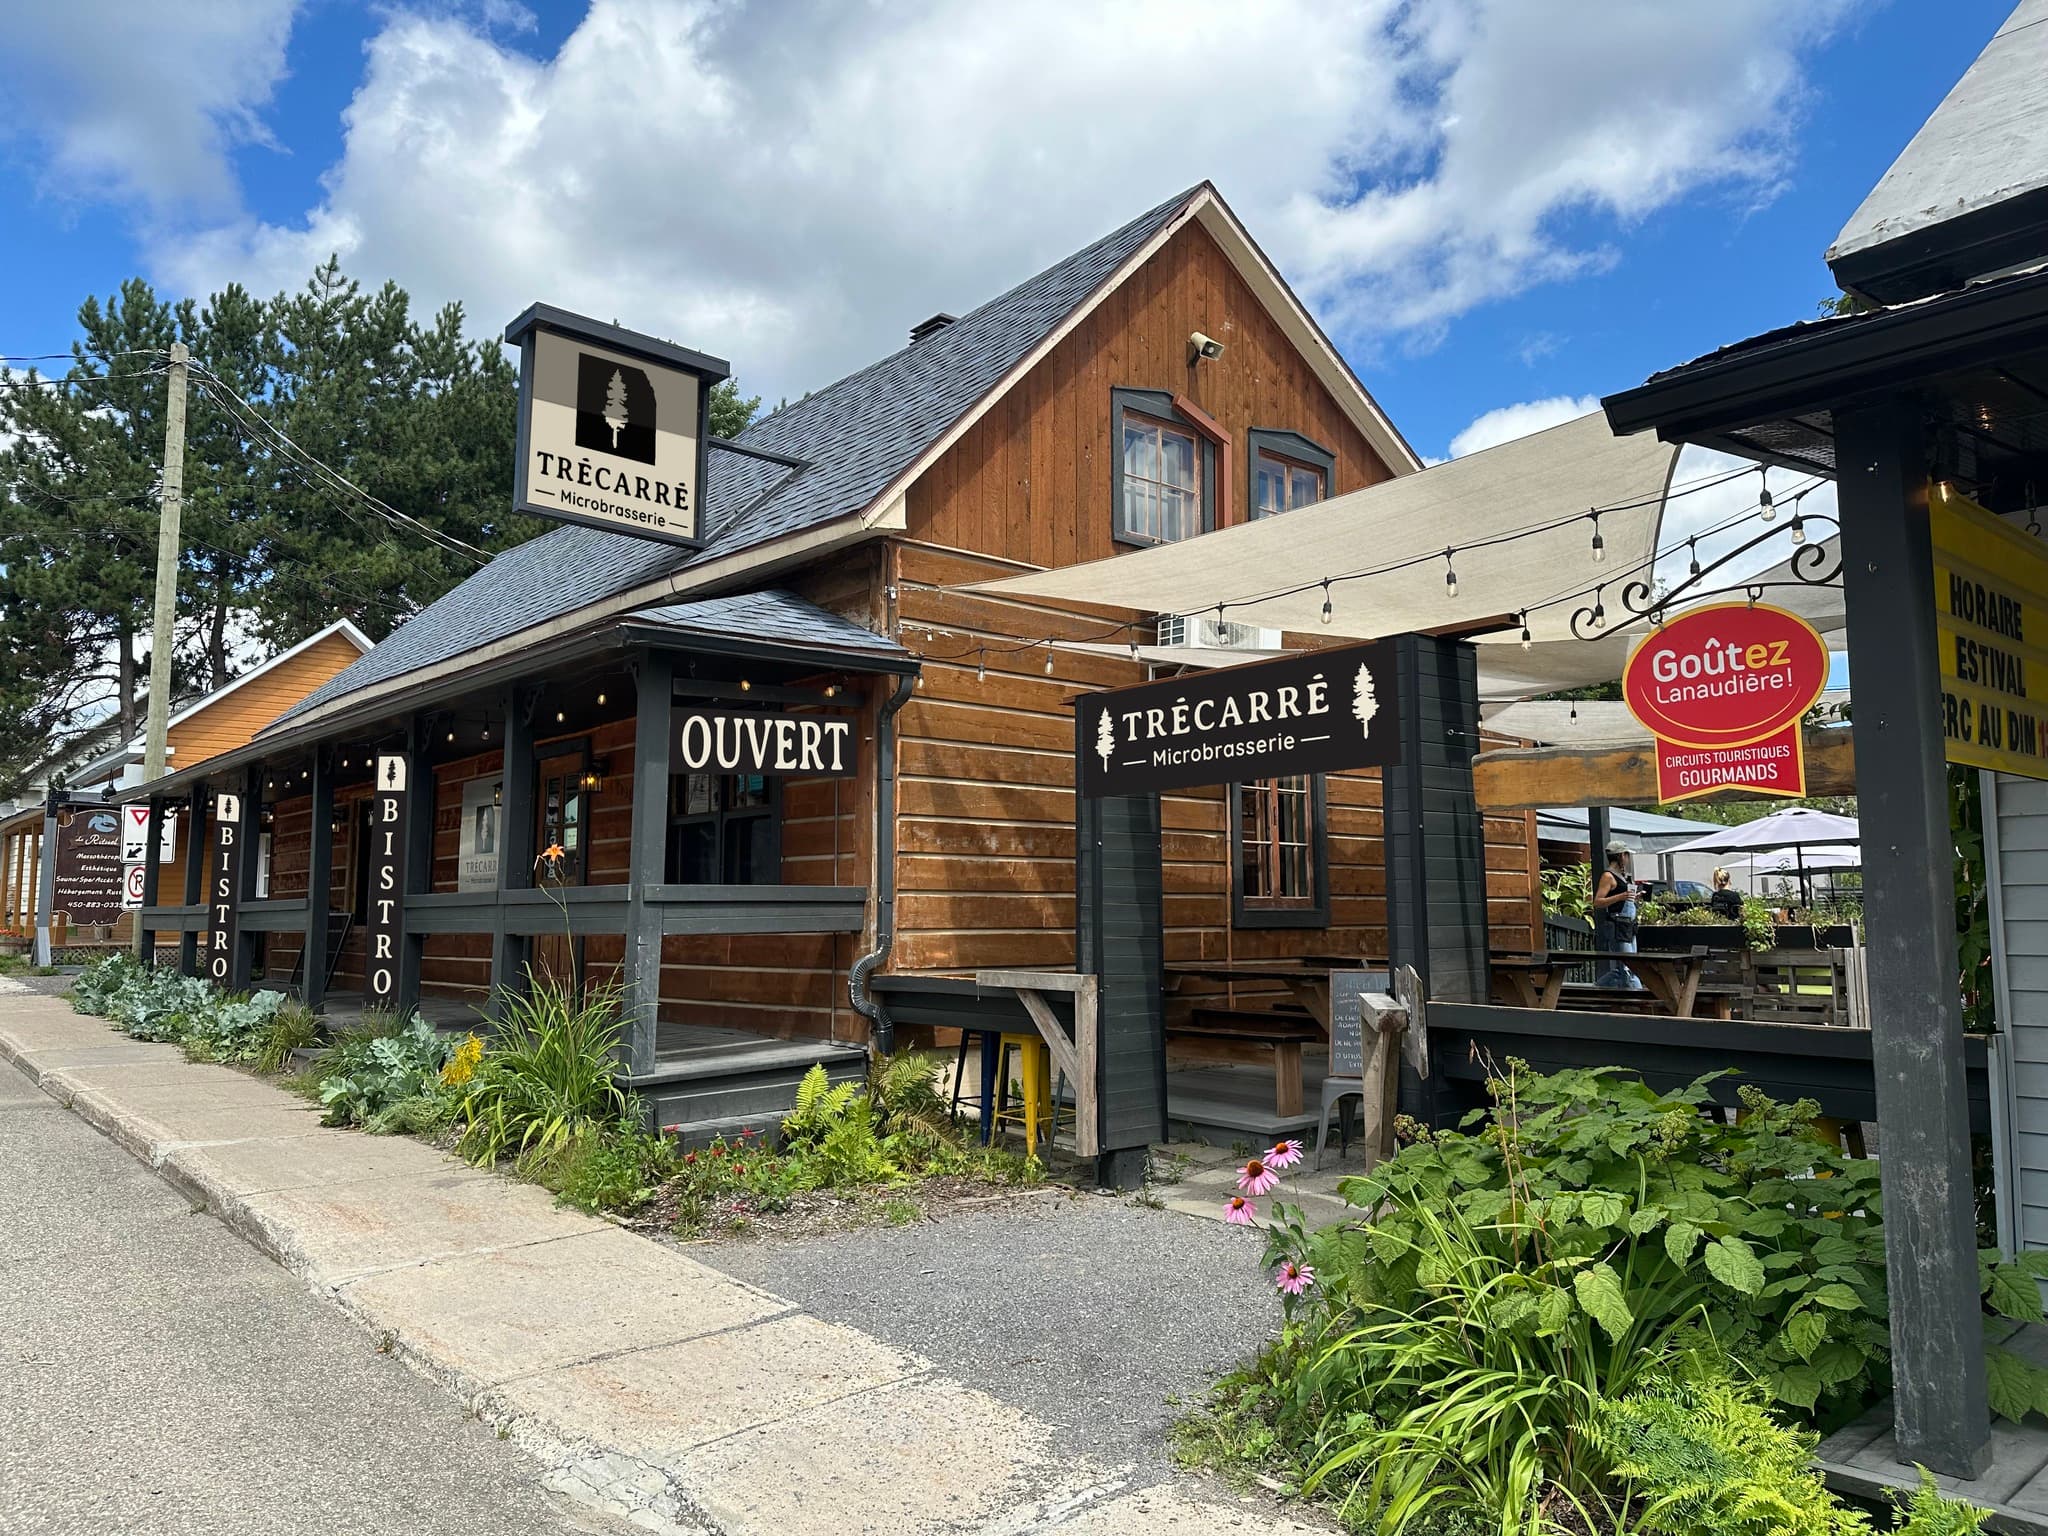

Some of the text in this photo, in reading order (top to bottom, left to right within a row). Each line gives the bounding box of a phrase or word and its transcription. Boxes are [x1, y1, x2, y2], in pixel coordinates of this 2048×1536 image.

[537, 451, 689, 511] TRÉCARRÉ
[561, 489, 666, 527] Microbrasserie
[1949, 573, 2023, 642] HORAIRE
[1652, 637, 1791, 682] Goûtez
[1955, 635, 2027, 698] ESTIVAL
[1122, 673, 1330, 741] TRÉCARRÉ
[1978, 703, 2002, 748] AU
[2007, 710, 2037, 756] DIM
[681, 715, 849, 771] OUVERT
[1153, 732, 1295, 767] Microbrasserie
[1665, 744, 1790, 768] CIRCUITS TOURISTIQUES
[1679, 762, 1778, 787] GOURMANDS
[85, 834, 119, 846] Rituel
[80, 864, 117, 873] Esthétique
[212, 826, 234, 978] BISTRO
[373, 798, 399, 995] BISTRO
